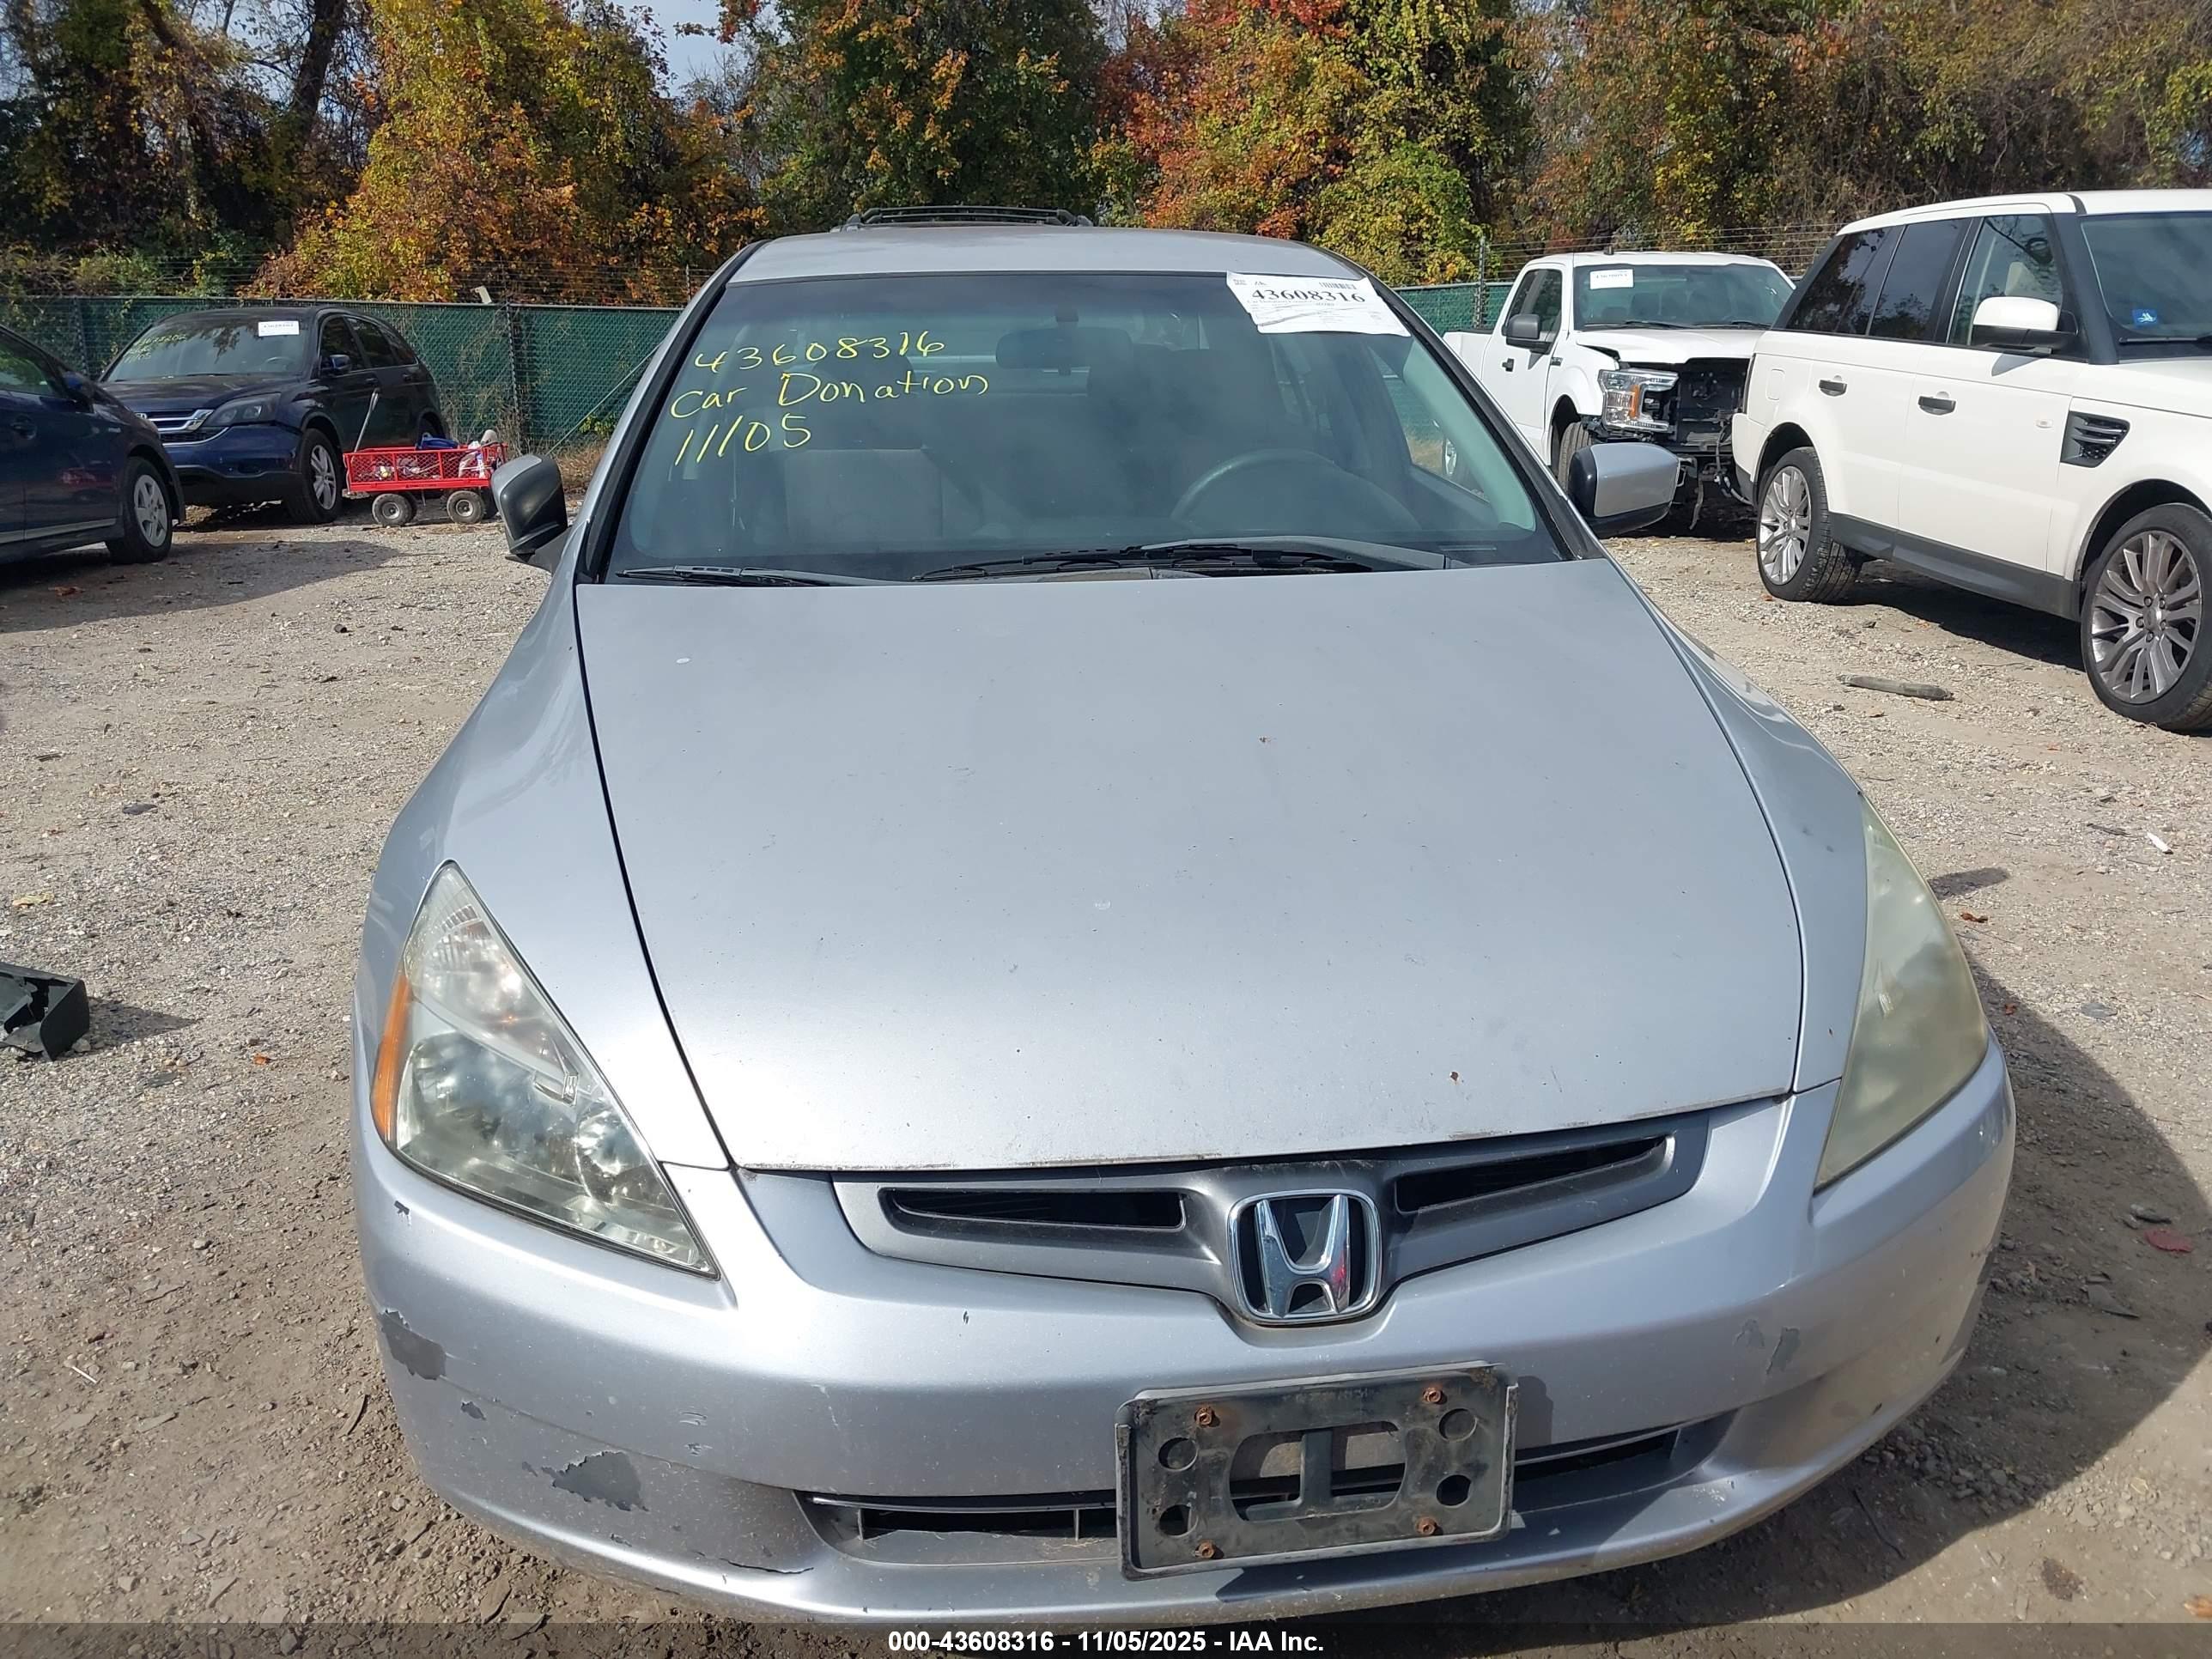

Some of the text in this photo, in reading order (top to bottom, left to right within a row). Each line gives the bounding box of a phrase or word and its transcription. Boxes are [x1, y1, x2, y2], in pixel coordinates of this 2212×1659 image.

[1252, 289, 1365, 302] 43608316
[695, 331, 945, 373] 43608316
[777, 370, 989, 407] Donation
